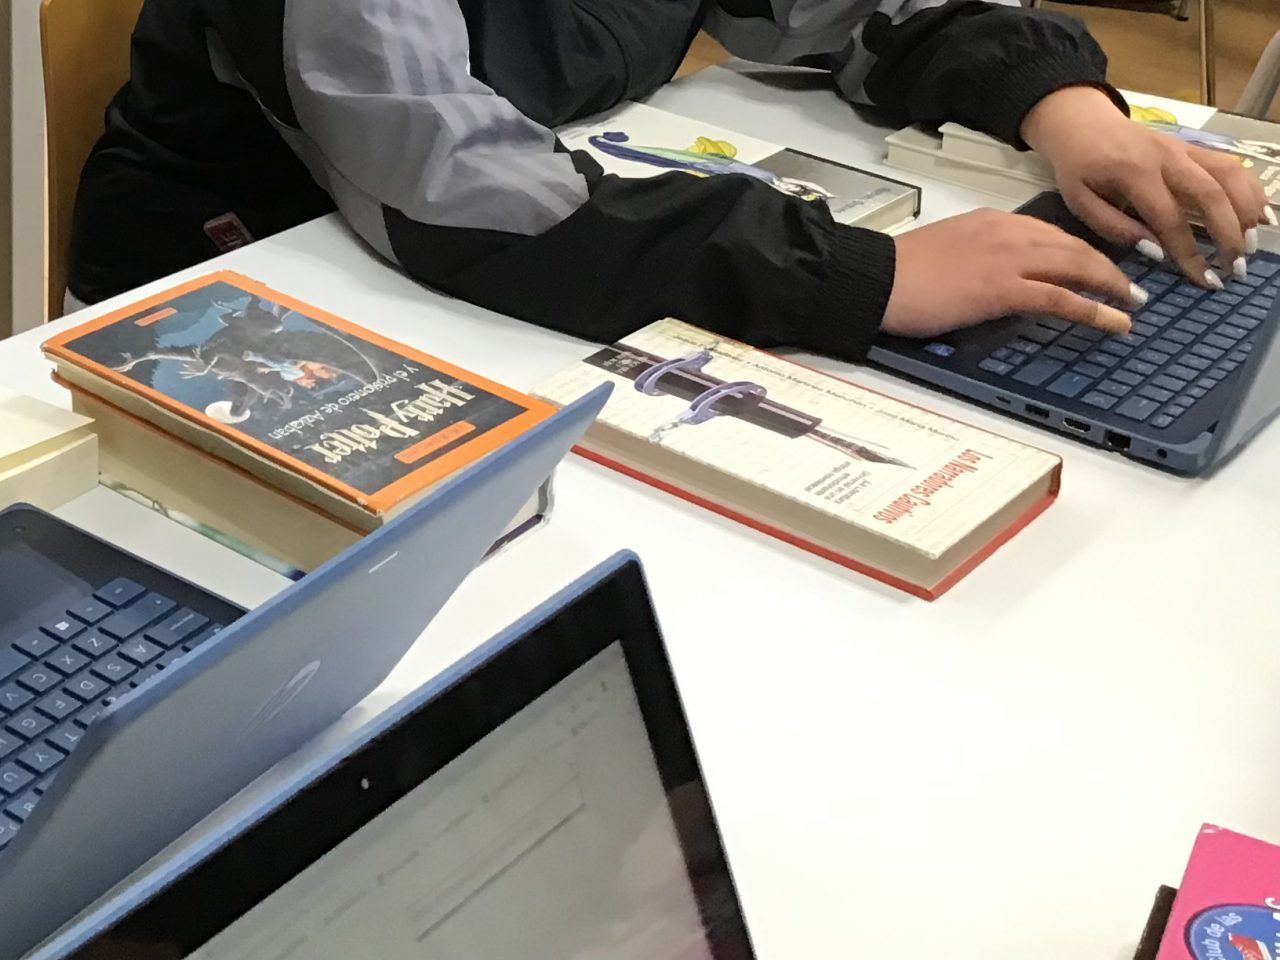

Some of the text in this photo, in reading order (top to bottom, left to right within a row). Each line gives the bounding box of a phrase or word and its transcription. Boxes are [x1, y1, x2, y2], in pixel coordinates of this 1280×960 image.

[338, 373, 398, 406] prisionero
[393, 369, 411, 381] el
[324, 401, 343, 416] de
[391, 378, 476, 423] Harry
[267, 411, 325, 440] Azkaban
[304, 406, 420, 464] Potter
[910, 459, 979, 498] Narradores
[873, 493, 932, 524] Cautivos
[1203, 923, 1225, 938] de
[1213, 912, 1243, 927] las
